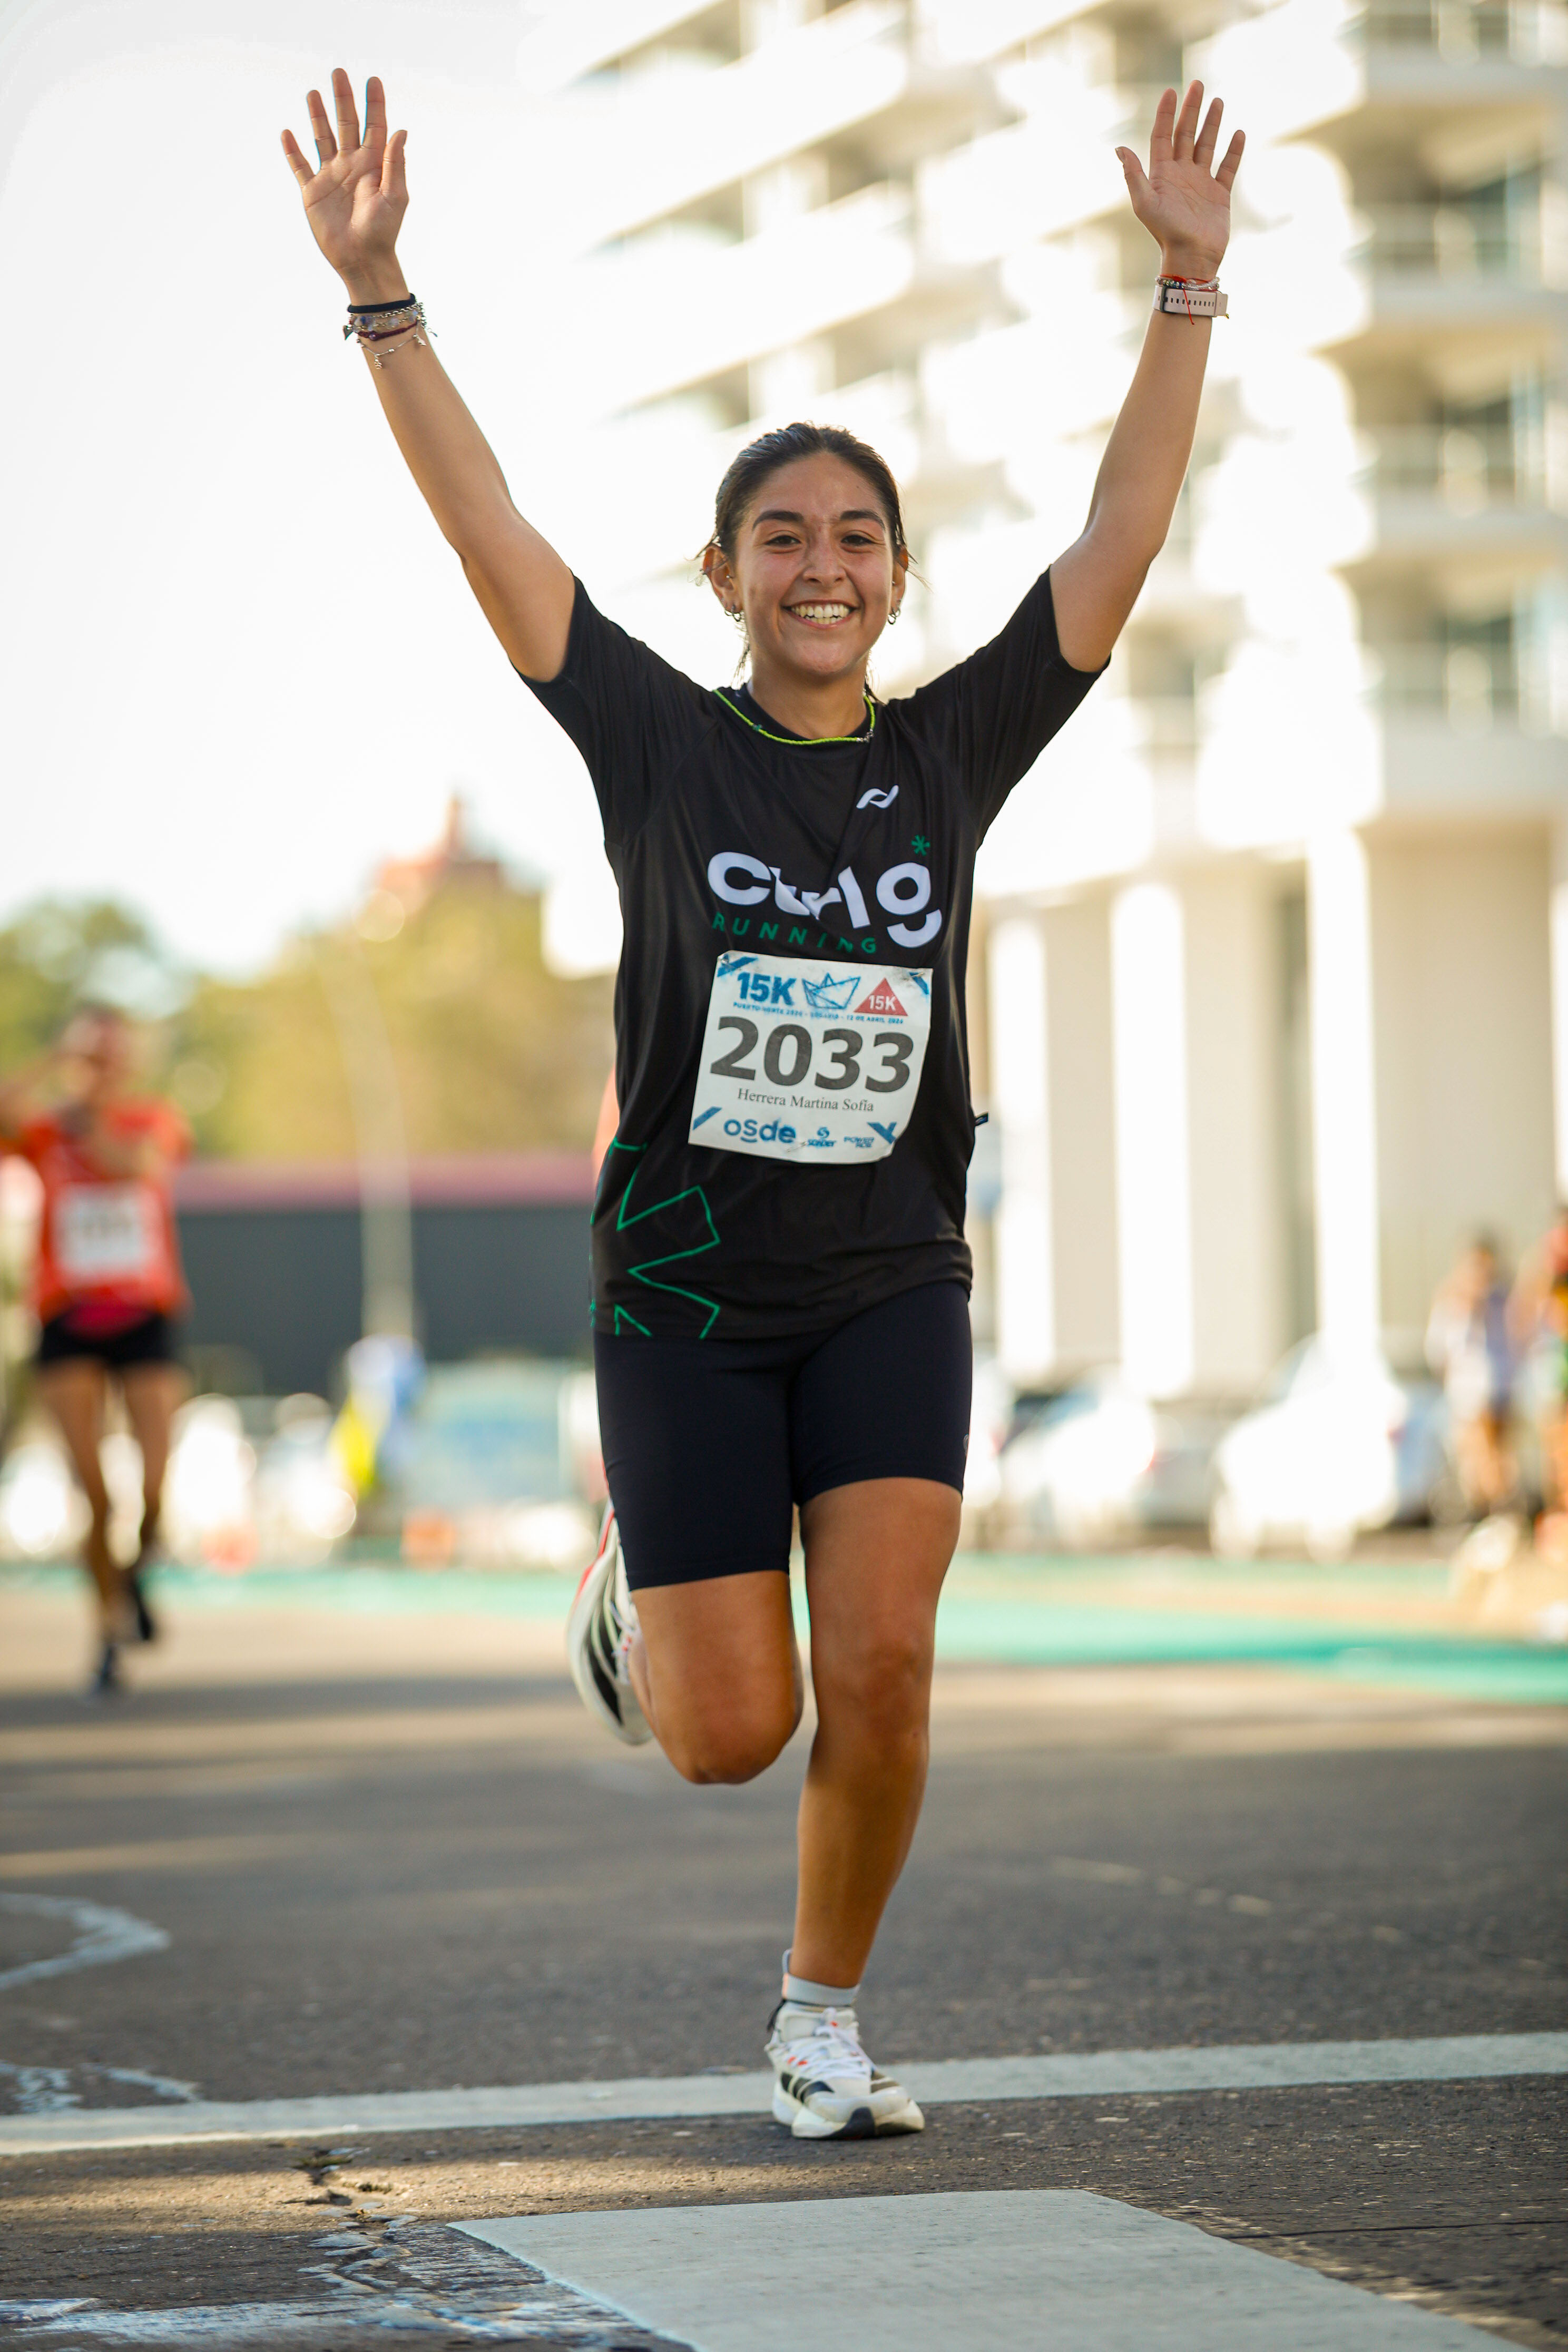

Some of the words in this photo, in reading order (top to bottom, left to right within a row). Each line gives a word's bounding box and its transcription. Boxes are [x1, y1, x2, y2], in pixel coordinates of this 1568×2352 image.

[712, 911, 877, 954] RUNNING
[738, 972, 797, 1005] 15K
[868, 995, 896, 1011] 15K
[709, 1015, 914, 1093] 2033
[737, 1087, 786, 1106] Herrera
[790, 1095, 838, 1110] Martina
[724, 1117, 796, 1143] osde
